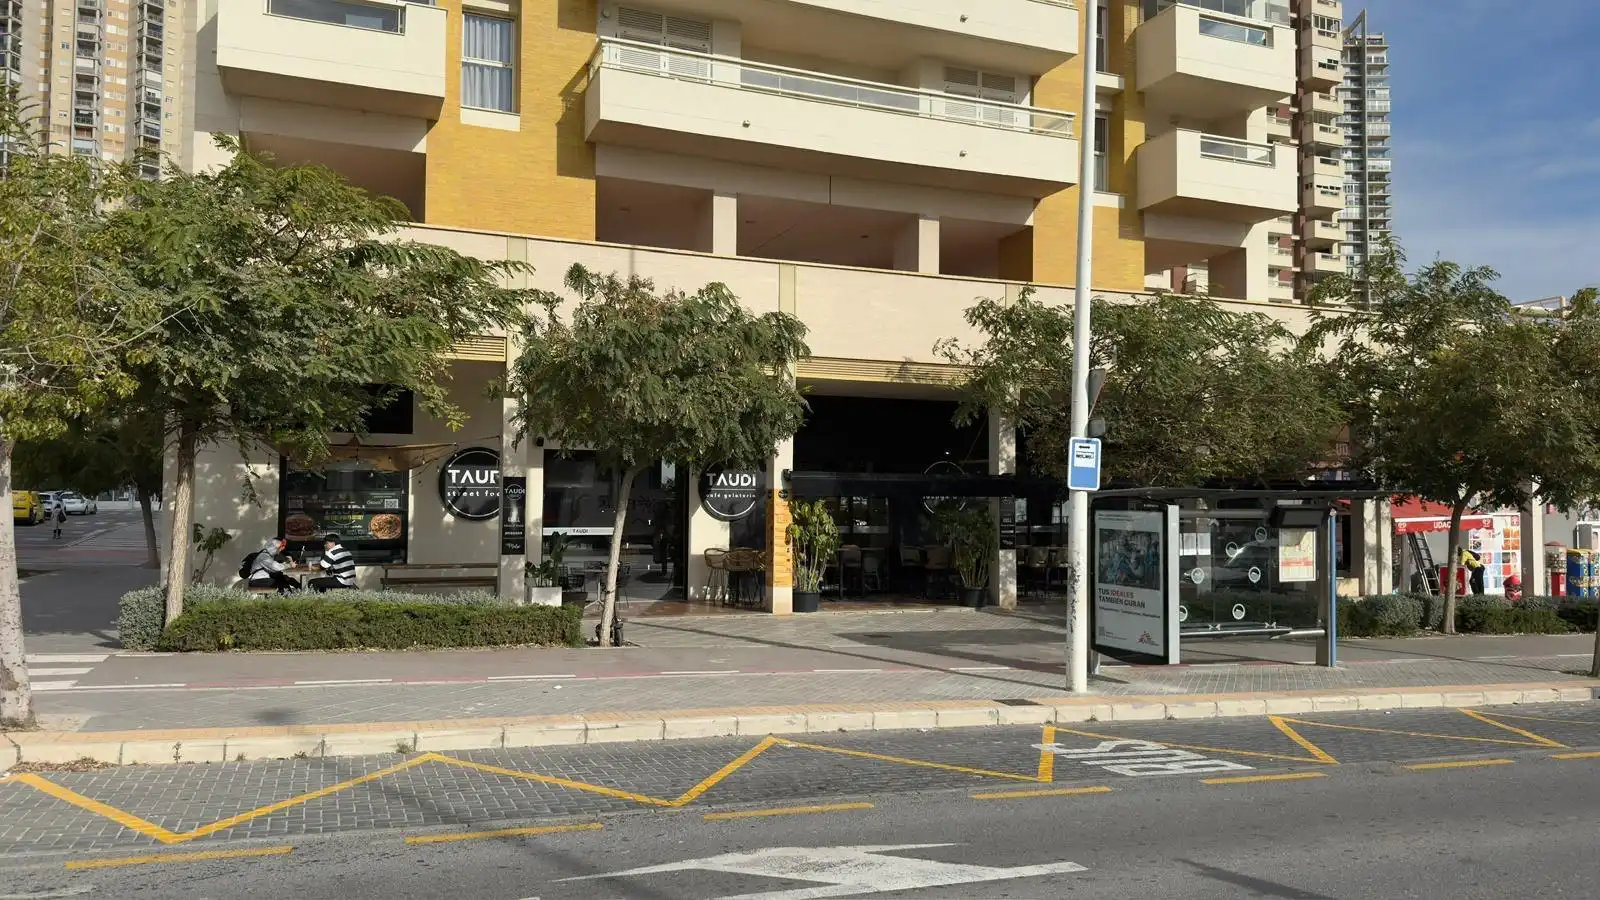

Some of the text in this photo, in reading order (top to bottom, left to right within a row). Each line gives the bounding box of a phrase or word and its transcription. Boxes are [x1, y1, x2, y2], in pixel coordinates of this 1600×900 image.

[447, 470, 499, 483] TAUD
[706, 473, 756, 486] TAUDI
[1098, 588, 1110, 596] TUS
[1031, 739, 1257, 776] BUS
